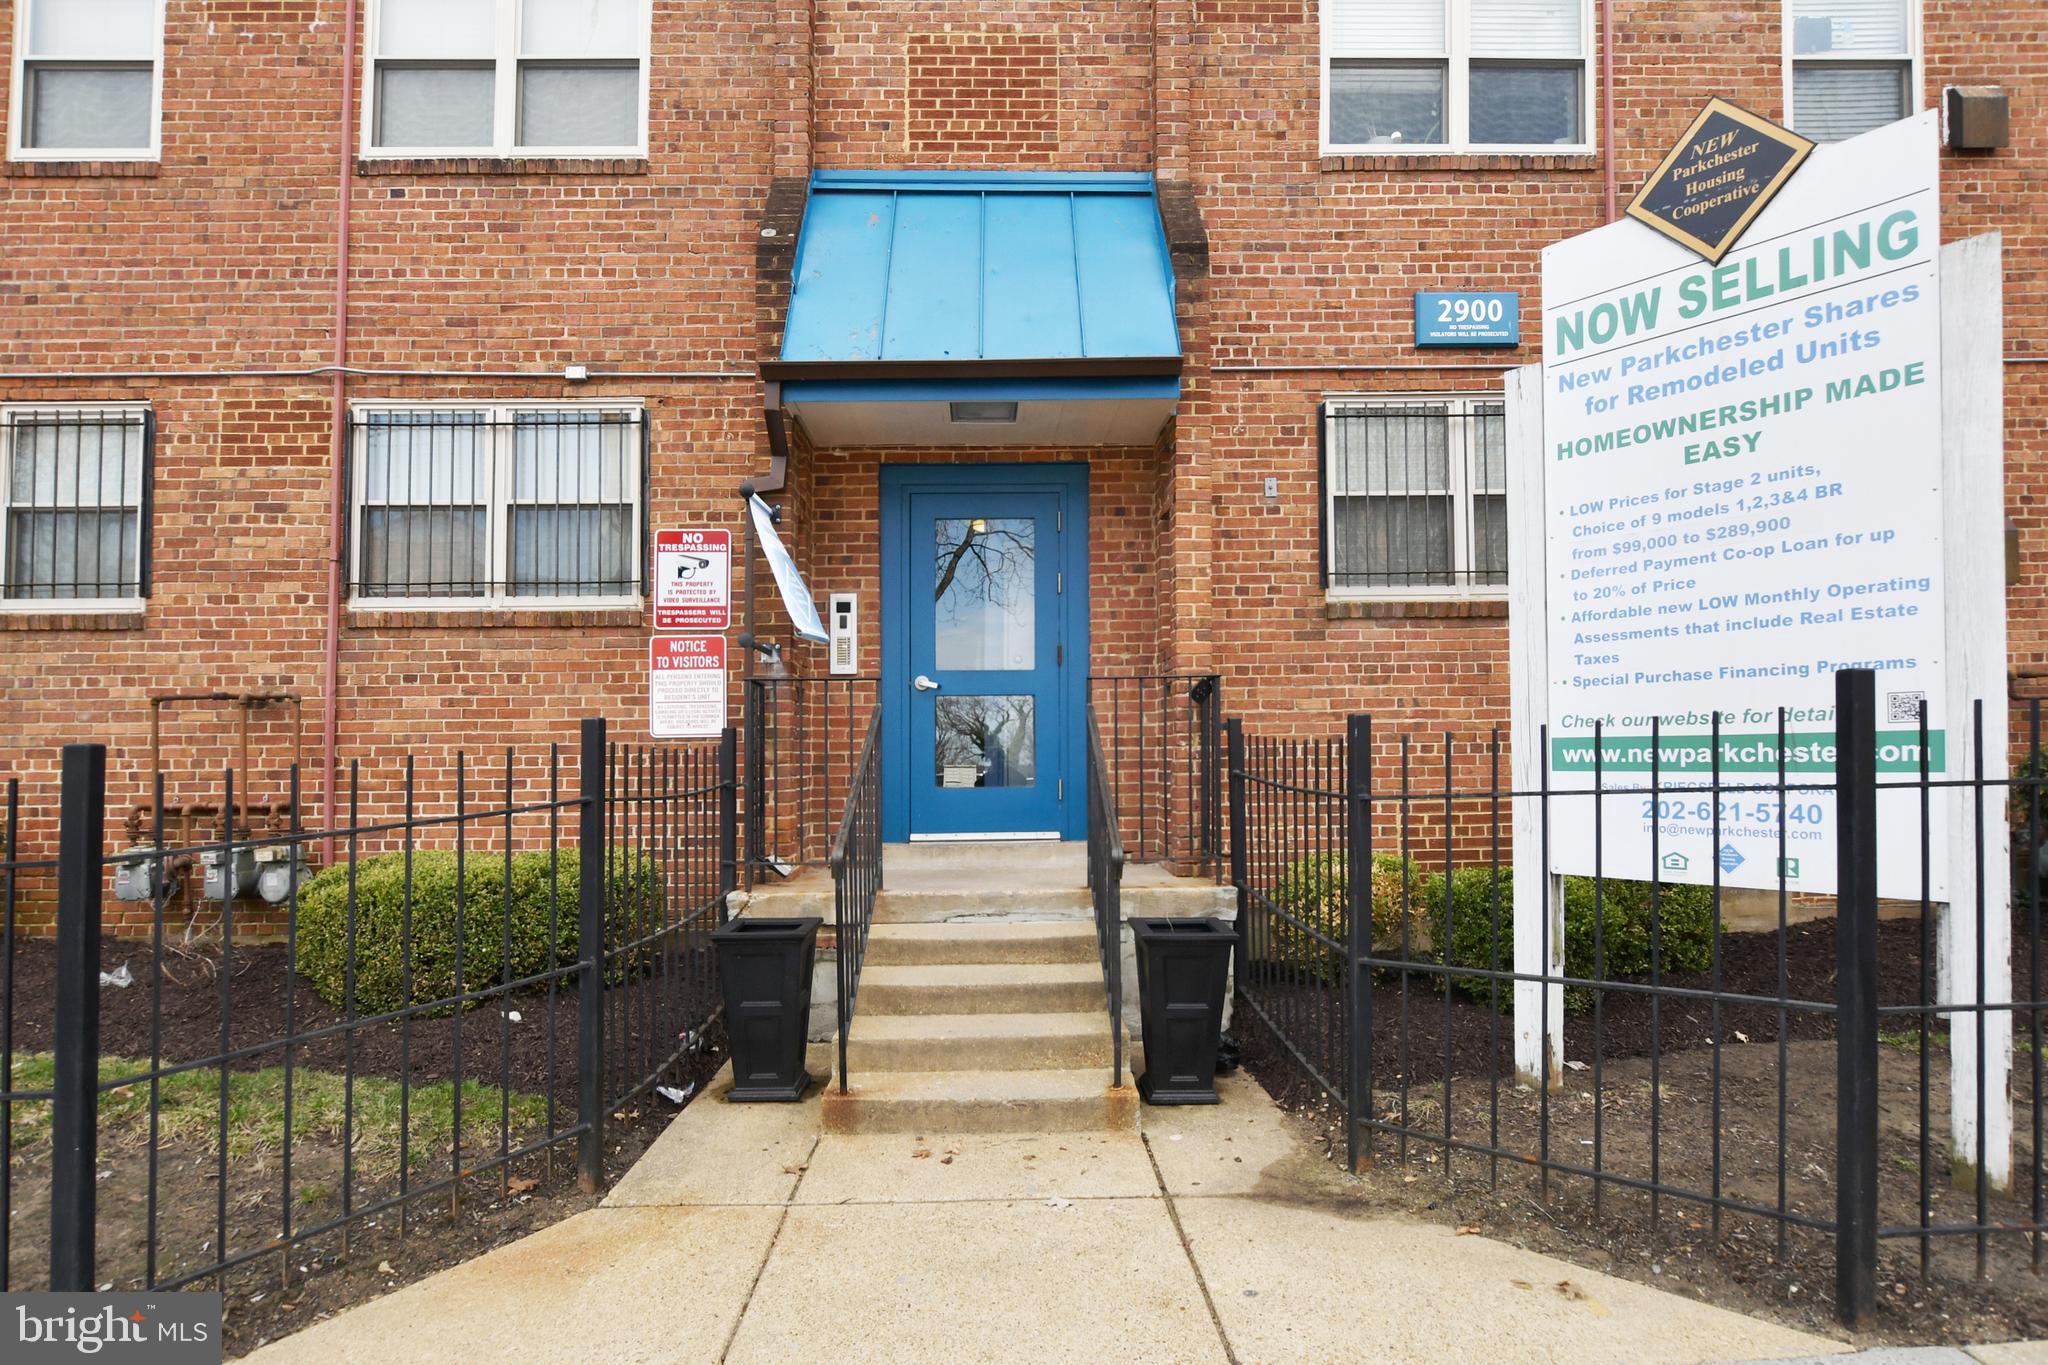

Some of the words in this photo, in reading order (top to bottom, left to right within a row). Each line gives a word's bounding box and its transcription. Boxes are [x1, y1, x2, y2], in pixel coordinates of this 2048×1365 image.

[1672, 141, 1760, 182] Parkchester
[1690, 129, 1740, 160] NEW
[1685, 167, 1745, 197] Housing
[1672, 182, 1760, 220] Cooperative
[1556, 287, 1661, 356] NOW
[1678, 209, 1919, 320] SELLING
[1437, 299, 1503, 322] 2900
[1558, 366, 1612, 393] New
[1620, 318, 1794, 378] Parkchester
[1803, 284, 1920, 328] Shares
[1584, 395, 1618, 415] for
[1627, 349, 1784, 405] Remodeled
[1796, 328, 1881, 364] Units
[1557, 387, 1813, 461] HOMEOWNERSHIP
[1825, 361, 1925, 404] MADE
[1683, 431, 1763, 465] EASY
[1570, 500, 1604, 517] LOW
[1609, 493, 1660, 511] Prices
[1664, 487, 1688, 500] for
[1693, 478, 1744, 496] Stage
[1750, 472, 1761, 486] 2
[1767, 465, 1821, 483] units,
[1572, 521, 1625, 538] Choice
[1630, 514, 1647, 529] of
[1652, 513, 1662, 525] 9
[1667, 503, 1730, 523] models
[1736, 488, 1808, 513] 1,2,3&4
[1815, 482, 1843, 499] BR
[658, 543, 727, 552] TRESPASSING
[682, 532, 704, 544] NO
[1571, 546, 1607, 560] from
[1612, 534, 1678, 555] $99,000
[1683, 531, 1700, 545] to
[1706, 516, 1791, 542] $289,900
[1571, 561, 1638, 580] Deferred
[1643, 550, 1717, 572] Payment
[1723, 544, 1775, 561] Co-op
[1781, 537, 1829, 554] Loan
[1835, 532, 1863, 547] for
[1870, 529, 1895, 544] up
[1571, 605, 1652, 623] Affordable
[1658, 603, 1693, 615] new
[1698, 594, 1739, 611] LOW
[1744, 587, 1821, 606] Monthly
[1826, 576, 1931, 600] Operating
[1573, 591, 1588, 602] to
[1593, 584, 1626, 600] 20%
[1631, 582, 1647, 596] of
[1653, 578, 1697, 593] Price
[1574, 624, 1680, 645] Assessments
[1685, 621, 1720, 635] that
[1725, 614, 1794, 632] include
[1800, 609, 1844, 625] Real
[1851, 603, 1919, 621] Estate
[656, 656, 669, 668] TO
[672, 655, 720, 668] VISITORS
[669, 640, 707, 653] NOTICE
[1574, 653, 1620, 666] Taxes
[1572, 673, 1629, 689] Special
[1634, 669, 1713, 685] Purchase
[1719, 663, 1810, 679] Financing
[1621, 716, 1653, 727] our
[1659, 710, 1736, 726] webste
[1743, 708, 1774, 723] for
[1642, 800, 1823, 824] 202-621-5740
